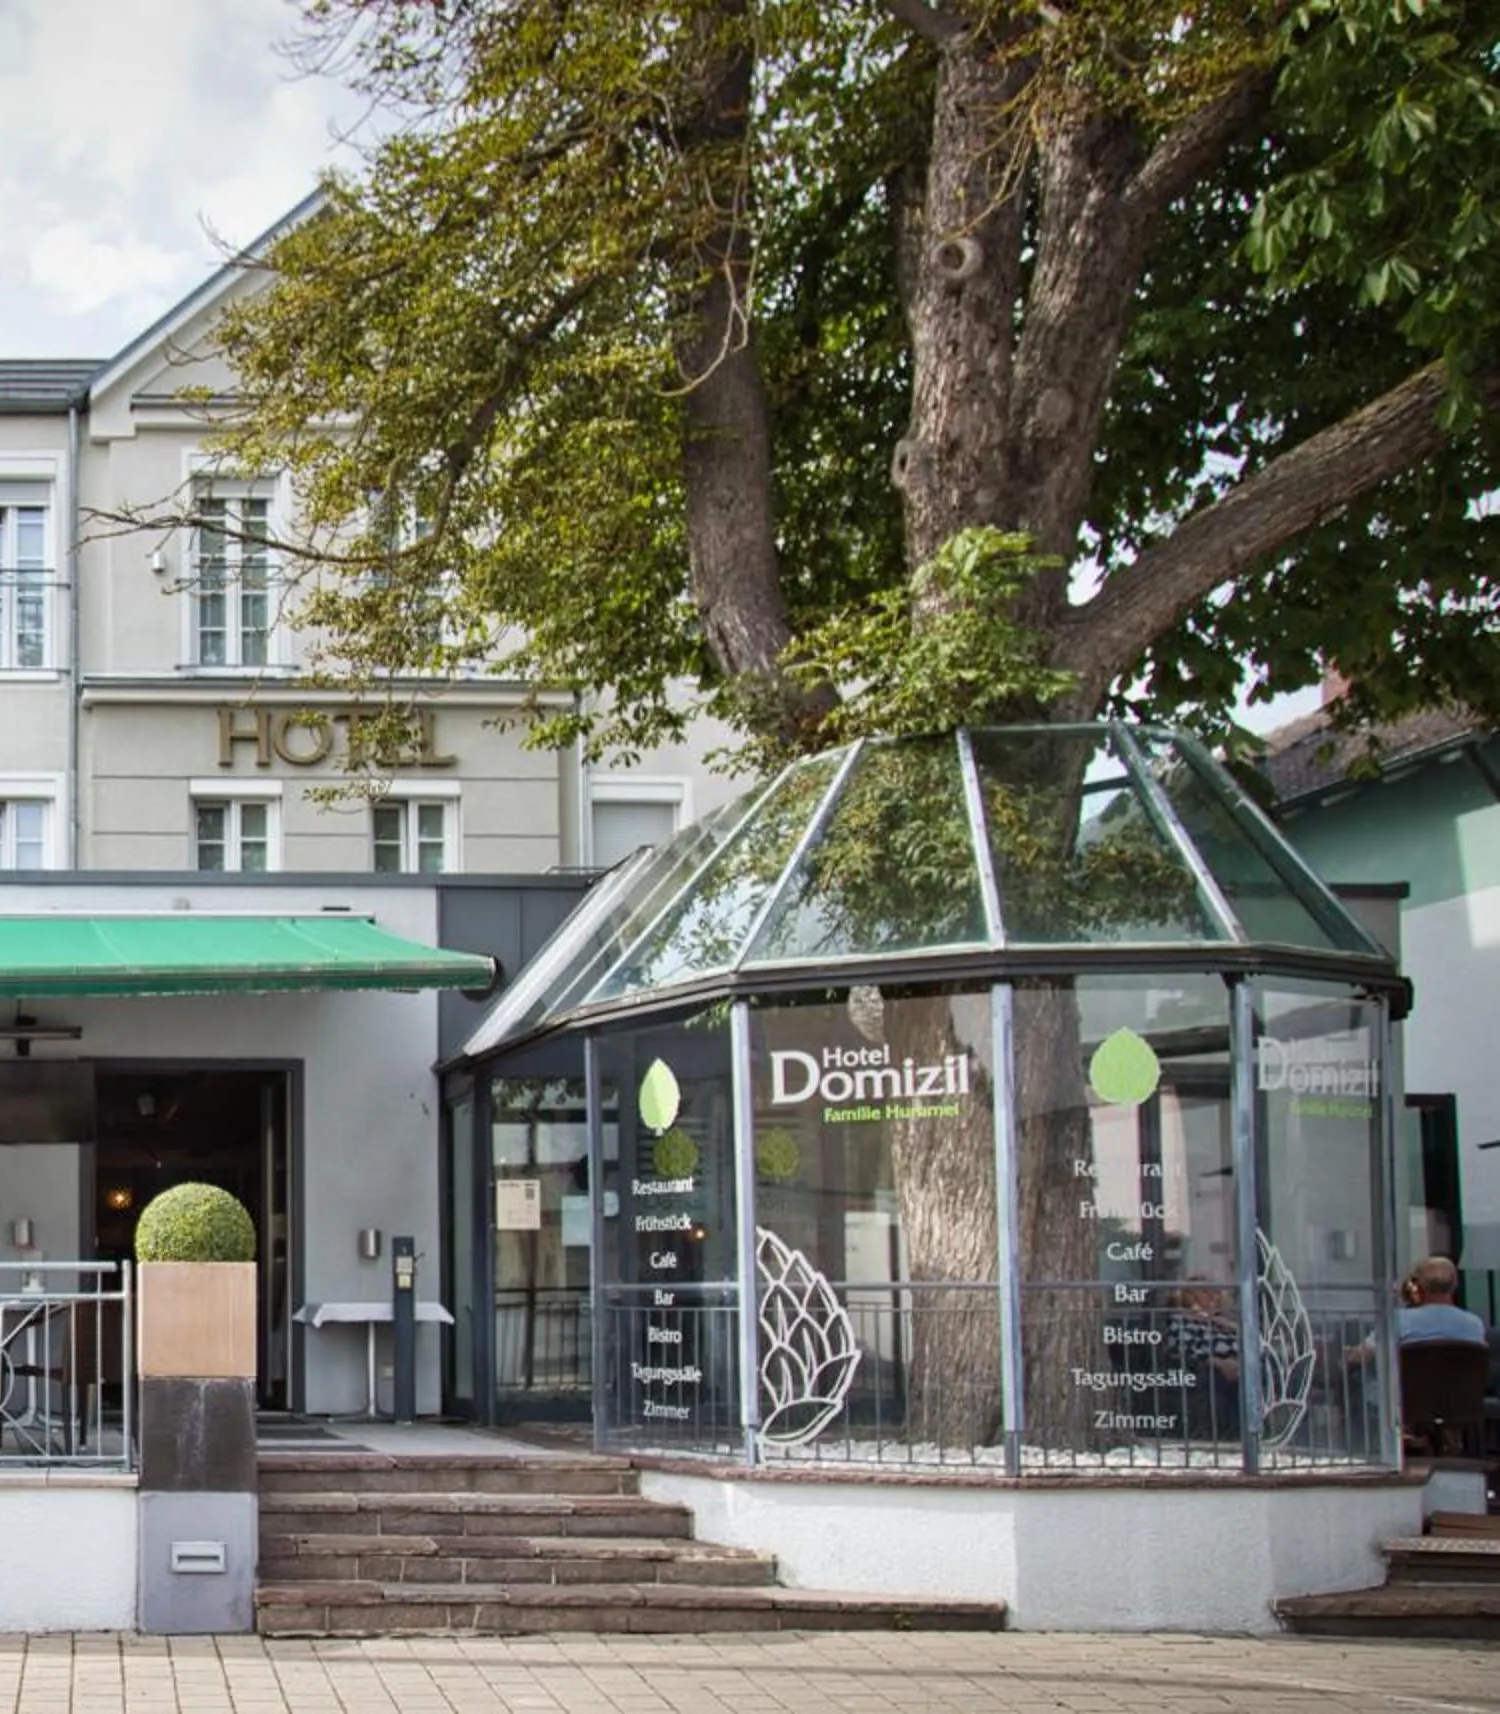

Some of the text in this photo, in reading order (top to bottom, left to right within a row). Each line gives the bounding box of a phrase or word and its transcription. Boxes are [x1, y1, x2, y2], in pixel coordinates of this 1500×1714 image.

[822, 1044, 890, 1068] Hotel
[771, 1051, 970, 1104] Domizil
[824, 1107, 881, 1123] Familie
[631, 1176, 694, 1195] Restaurant
[635, 1212, 692, 1232] Frühstück
[649, 1251, 677, 1269] Café
[1106, 1241, 1154, 1261] Café
[654, 1288, 675, 1306] Bar
[1114, 1283, 1149, 1304] Bar
[647, 1325, 682, 1344] Bistro
[1102, 1325, 1163, 1345] Bistro
[1070, 1367, 1198, 1392] Tagungssäle
[643, 1400, 690, 1419] Zimmer
[1093, 1410, 1178, 1429] Zimmer
